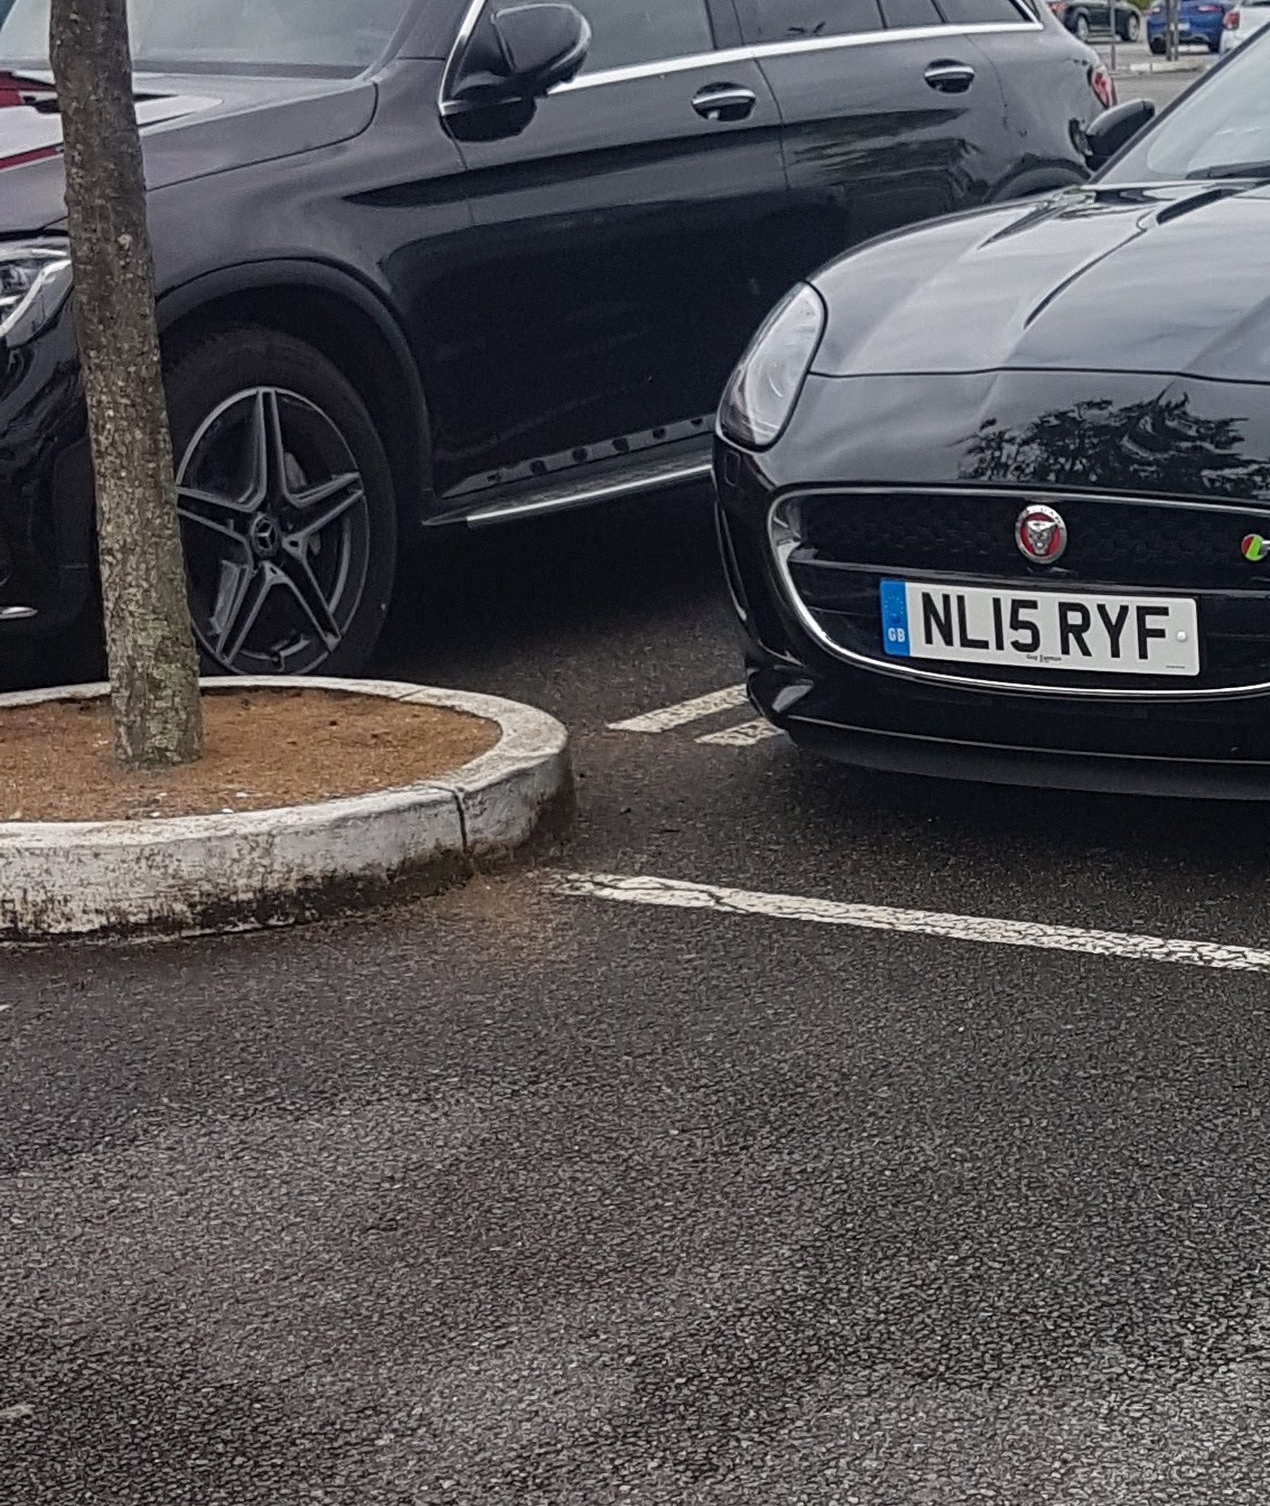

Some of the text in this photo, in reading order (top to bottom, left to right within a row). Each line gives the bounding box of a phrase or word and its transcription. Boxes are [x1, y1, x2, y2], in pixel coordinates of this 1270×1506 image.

[887, 627, 906, 643] GB
[921, 591, 1170, 661] NL15 RYF
